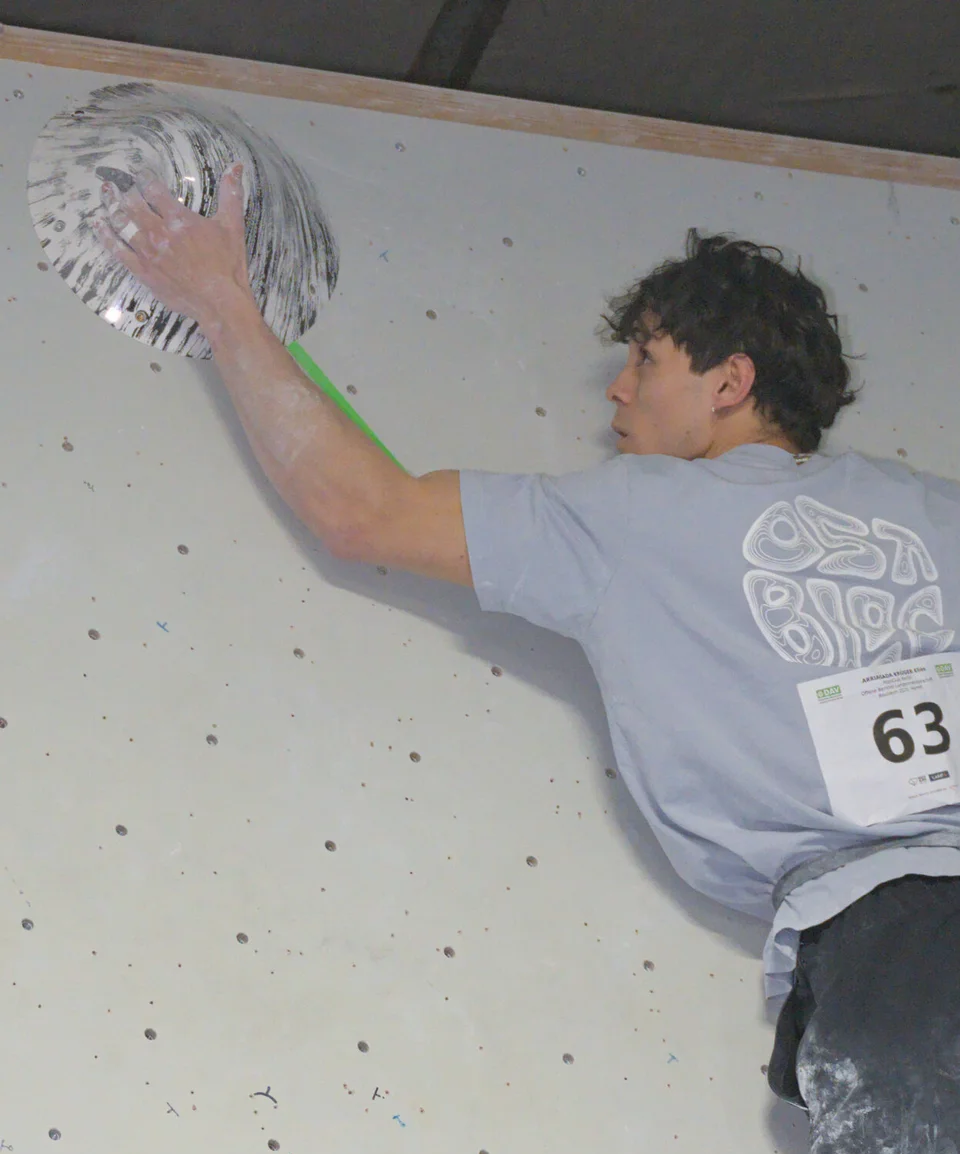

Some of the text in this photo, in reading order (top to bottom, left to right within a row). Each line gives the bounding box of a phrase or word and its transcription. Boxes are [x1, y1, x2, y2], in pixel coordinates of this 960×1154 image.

[742, 495, 938, 585] OST
[823, 686, 840, 697] DAV
[872, 701, 950, 763] 63
